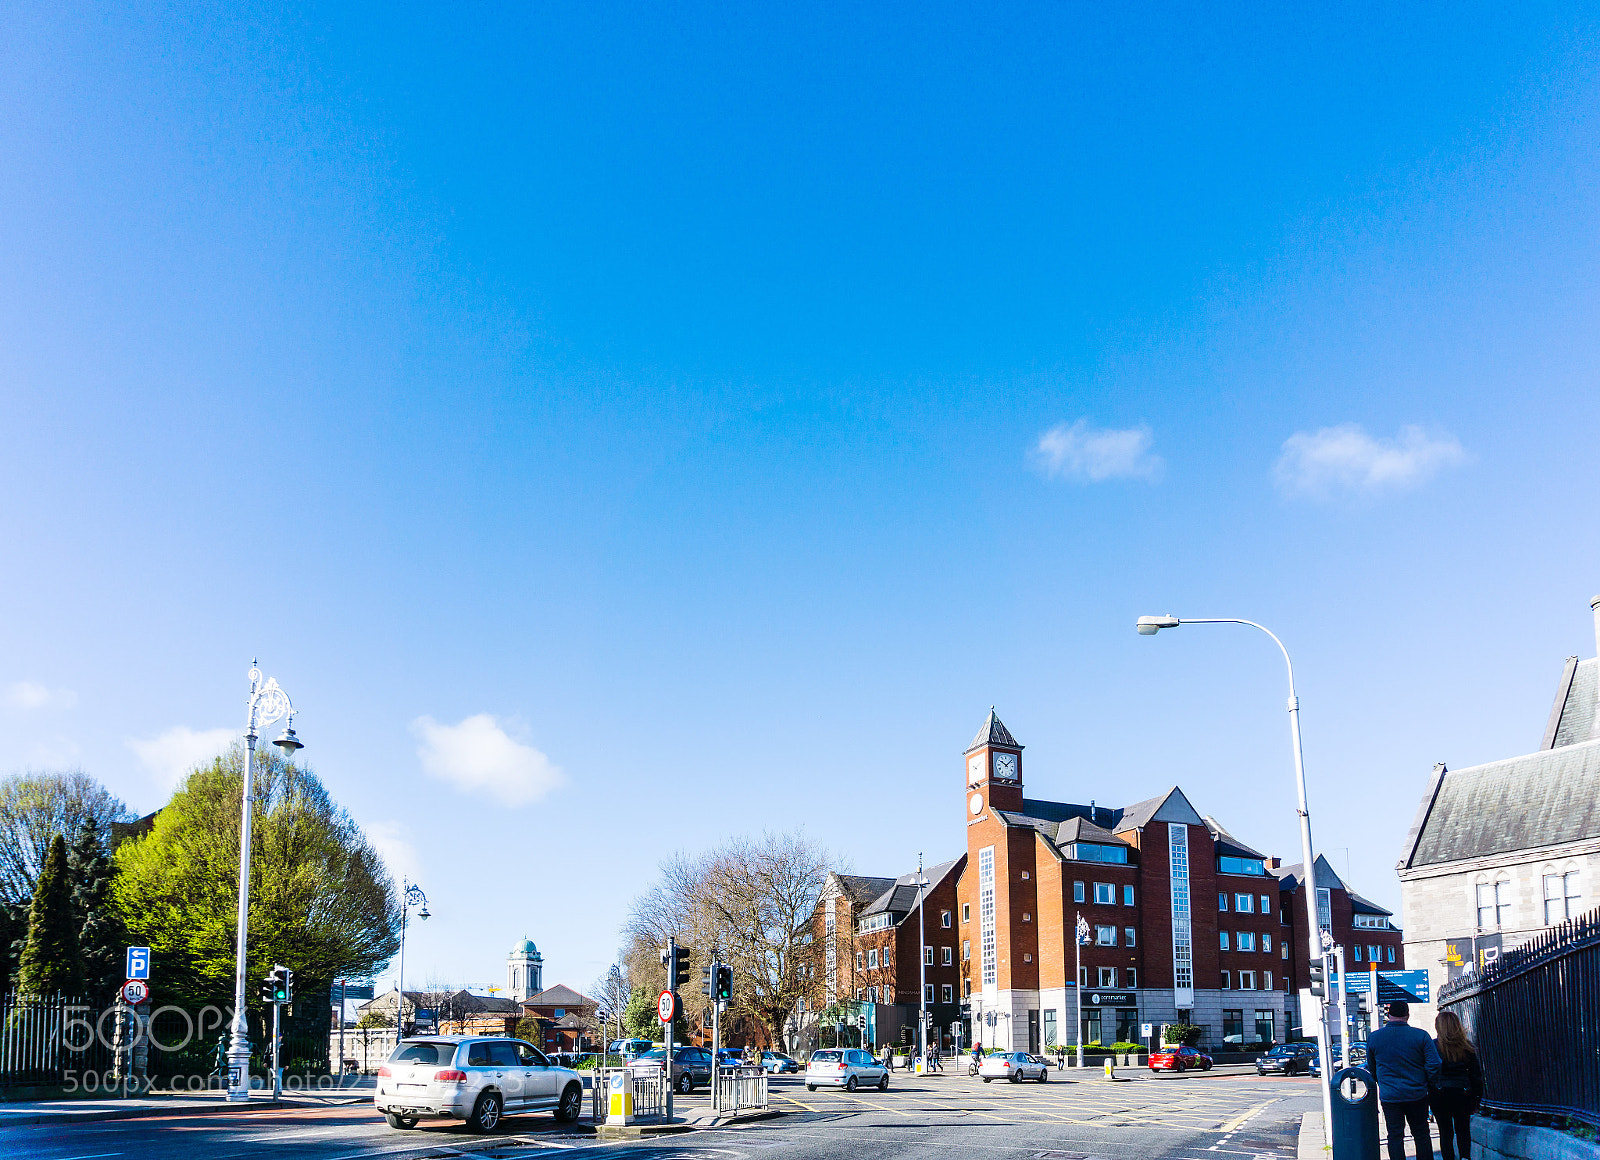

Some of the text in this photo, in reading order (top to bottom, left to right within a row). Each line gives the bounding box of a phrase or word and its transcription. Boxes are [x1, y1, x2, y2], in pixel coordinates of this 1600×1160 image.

[131, 958, 145, 977] P
[128, 985, 142, 996] 50
[661, 998, 671, 1011] 50
